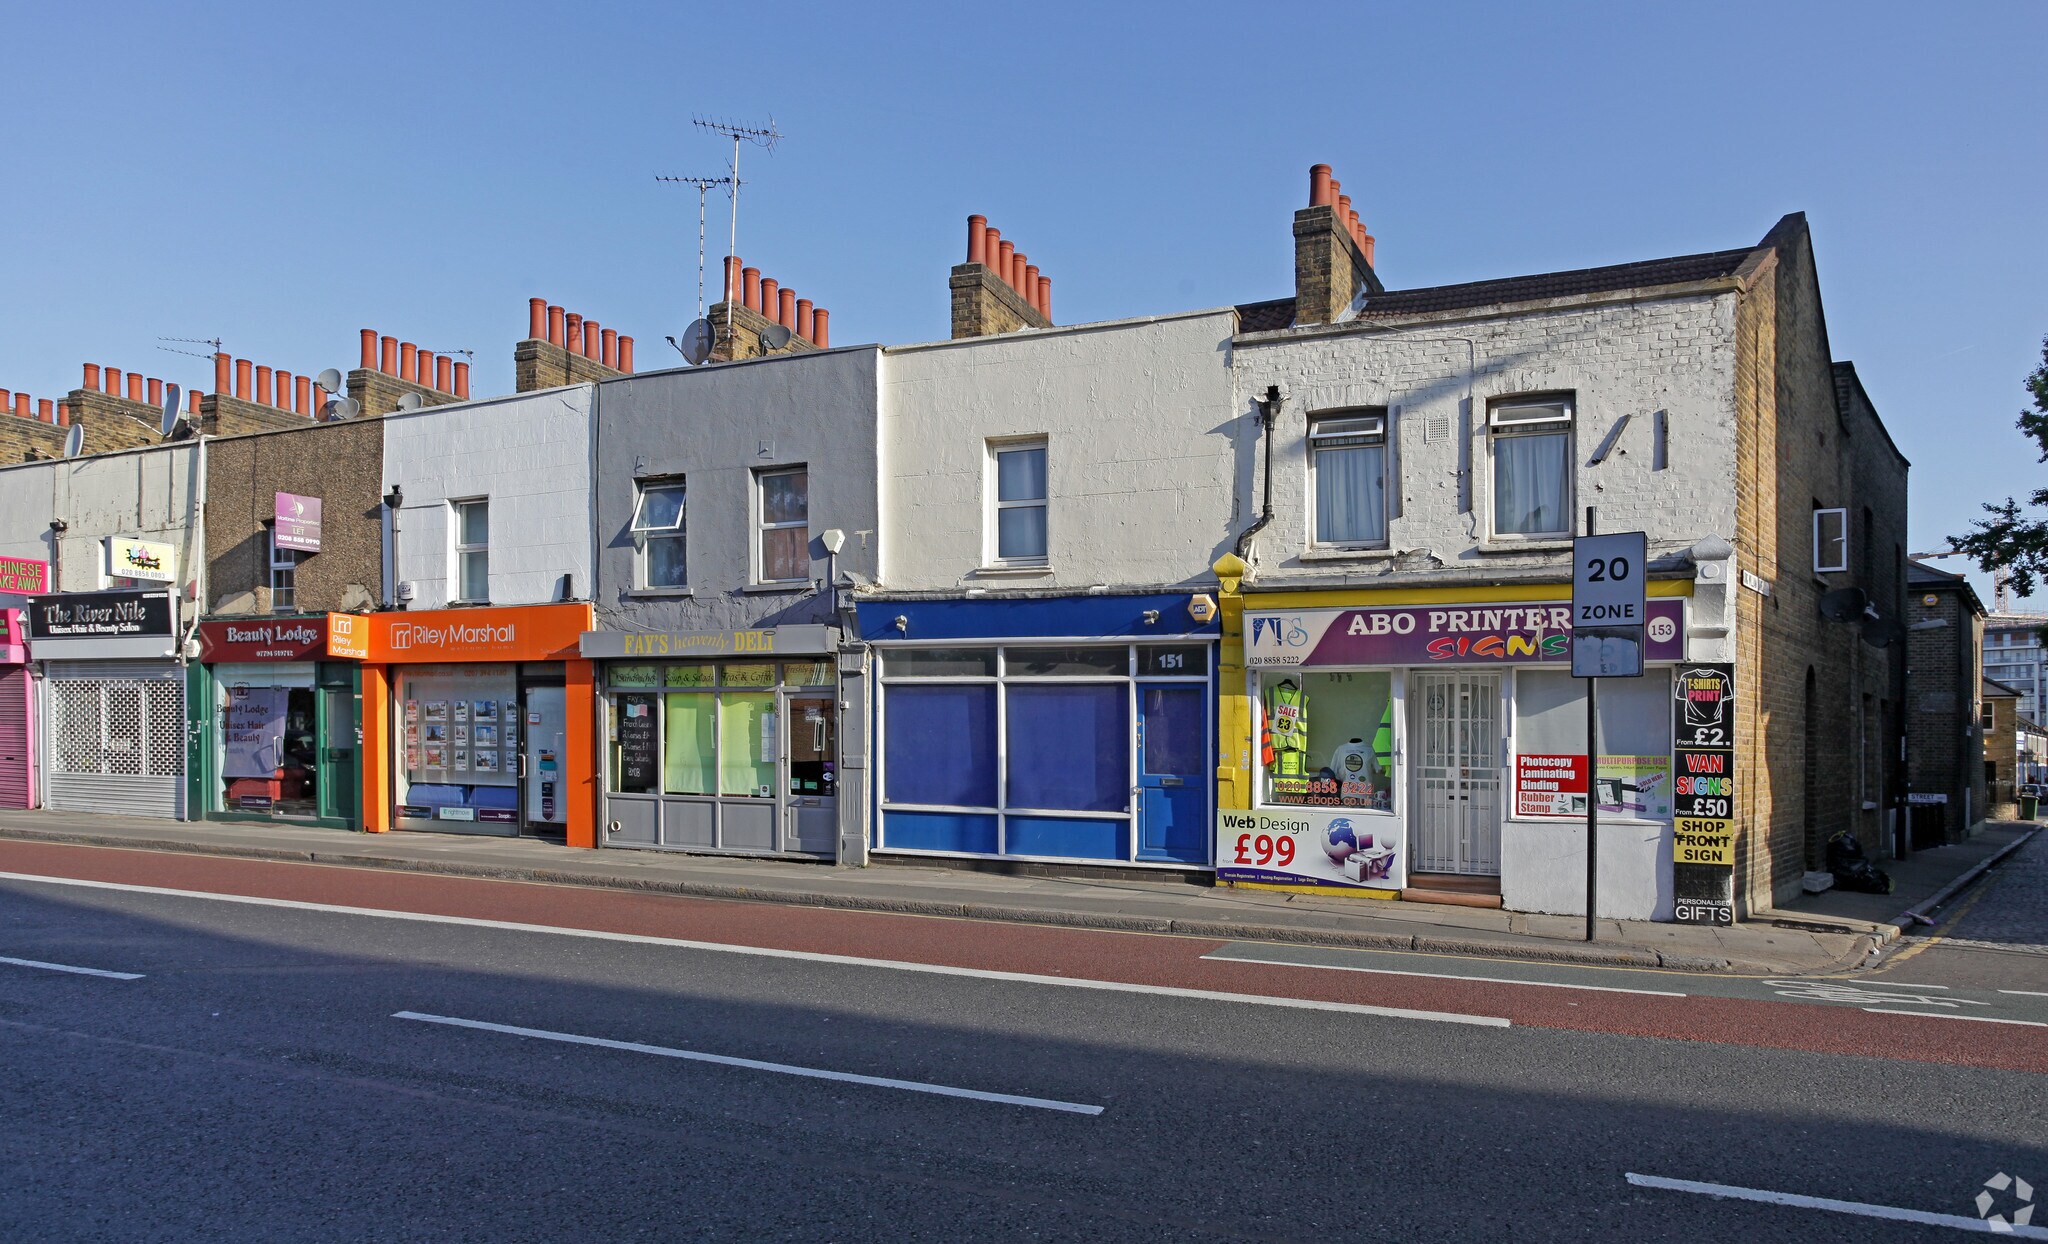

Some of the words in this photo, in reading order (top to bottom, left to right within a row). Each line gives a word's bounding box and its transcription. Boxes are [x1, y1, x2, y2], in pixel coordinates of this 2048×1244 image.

[0, 561, 42, 577] HINESE
[1588, 557, 1629, 582] 20
[17, 577, 42, 591] AWAY
[43, 603, 71, 624] The
[73, 604, 112, 623] River
[114, 600, 146, 621] Nile
[1194, 604, 1206, 613] ADT
[1582, 604, 1634, 619] ZONE
[49, 625, 72, 634] Unisex
[72, 624, 87, 633] Hair
[88, 624, 95, 633] &
[96, 623, 119, 635] Beauty
[120, 622, 140, 632] Salon
[1347, 613, 1416, 635] ABO
[1651, 624, 1672, 636] 153
[226, 626, 272, 645] Beauty
[275, 625, 317, 645] Lodge
[333, 635, 351, 646] Riley
[413, 625, 448, 648] Riley
[450, 623, 515, 644] Marshall
[624, 634, 668, 654] FAY'S
[673, 632, 729, 650] heavenly
[734, 631, 773, 651] DELI
[1426, 634, 1569, 660] SIGNS
[333, 645, 366, 657] Marshall
[1159, 654, 1182, 668] 151
[1250, 657, 1262, 665] 020
[1264, 656, 1281, 665] 8858
[1282, 656, 1299, 664] 5222
[1688, 678, 1720, 690] T-SHIRTS
[1688, 690, 1720, 702] PRINT
[245, 704, 268, 716] Lodge
[1278, 705, 1297, 718] SALE
[1277, 718, 1291, 730] £3
[1520, 756, 1572, 768] Photocopy
[1653, 757, 1667, 765] USE
[1686, 754, 1723, 773] VAN
[1520, 768, 1575, 780] Laminating
[1639, 778, 1652, 787] SOLD
[1651, 773, 1664, 783] HERE
[1277, 782, 1300, 791] 020
[1305, 781, 1338, 793] 8858
[1342, 782, 1374, 794] 5222
[1521, 780, 1559, 791] Binding
[1676, 776, 1732, 796] SIGNS
[1279, 794, 1373, 806] www.abops.co.uk
[1521, 792, 1555, 803] Rubber
[1521, 803, 1550, 814] Stamp
[1693, 798, 1728, 817] £50
[1223, 815, 1256, 829] Web
[1260, 817, 1310, 834] Design
[1682, 820, 1725, 833] SHOP
[1676, 834, 1730, 848] FRONT
[1234, 833, 1296, 867] £99
[1684, 849, 1723, 861] SIGN
[1677, 898, 1731, 907] PERSONALISED
[1675, 905, 1731, 922] GIFTS
